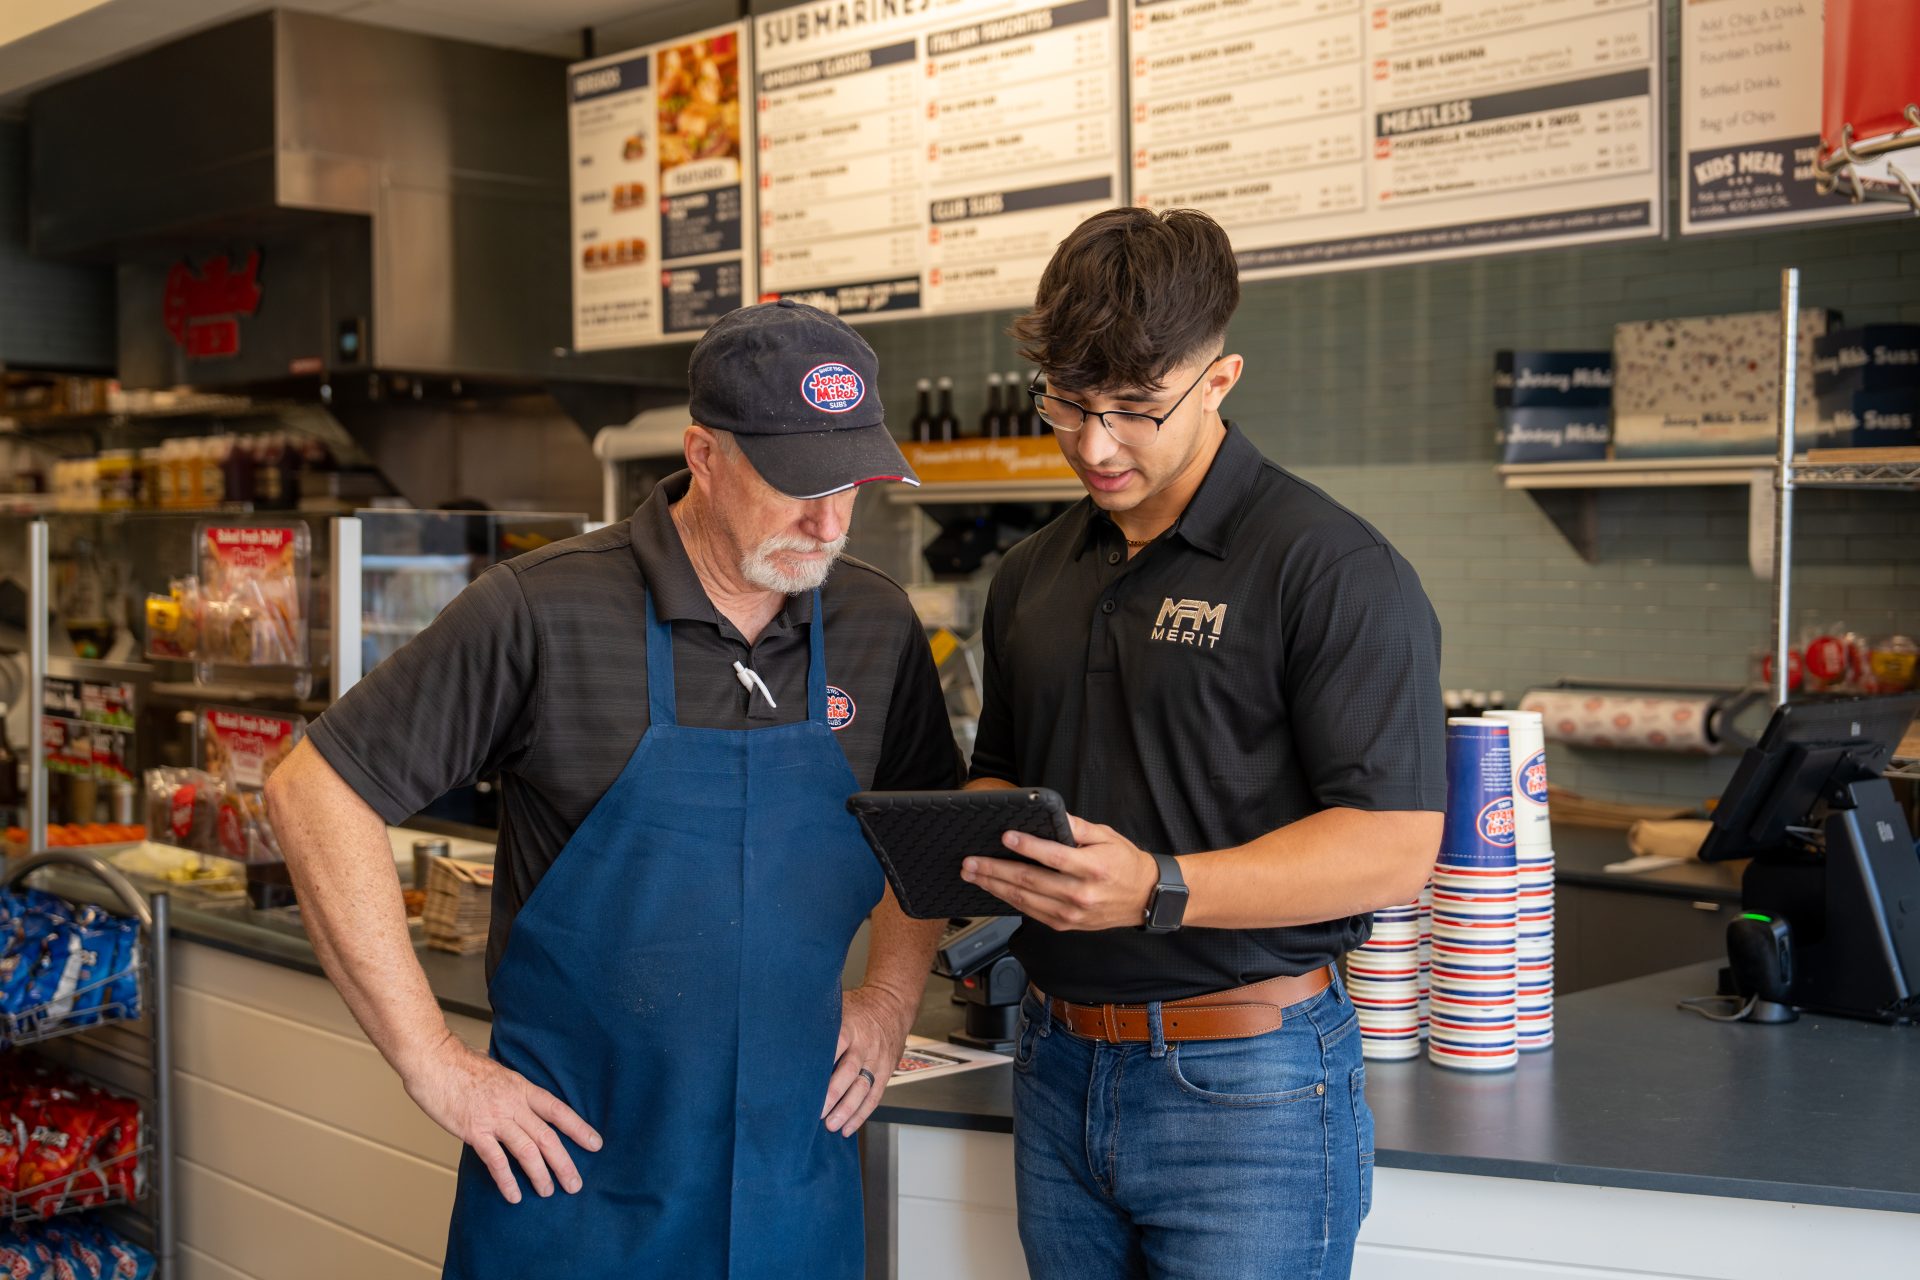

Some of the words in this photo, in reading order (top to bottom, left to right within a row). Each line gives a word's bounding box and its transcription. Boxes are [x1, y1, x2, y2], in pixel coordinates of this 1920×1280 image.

[1382, 100, 1472, 134] MEATLESS
[1694, 154, 1735, 186] KIDS
[1738, 151, 1784, 176] MEAL
[809, 372, 858, 388] Jersey
[815, 384, 858, 403] Mike's
[829, 400, 848, 409] SUBS
[1863, 410, 1912, 431] SUBS
[1506, 422, 1563, 448] Jersey
[1151, 627, 1220, 648] MERIT
[827, 705, 850, 719] ike's
